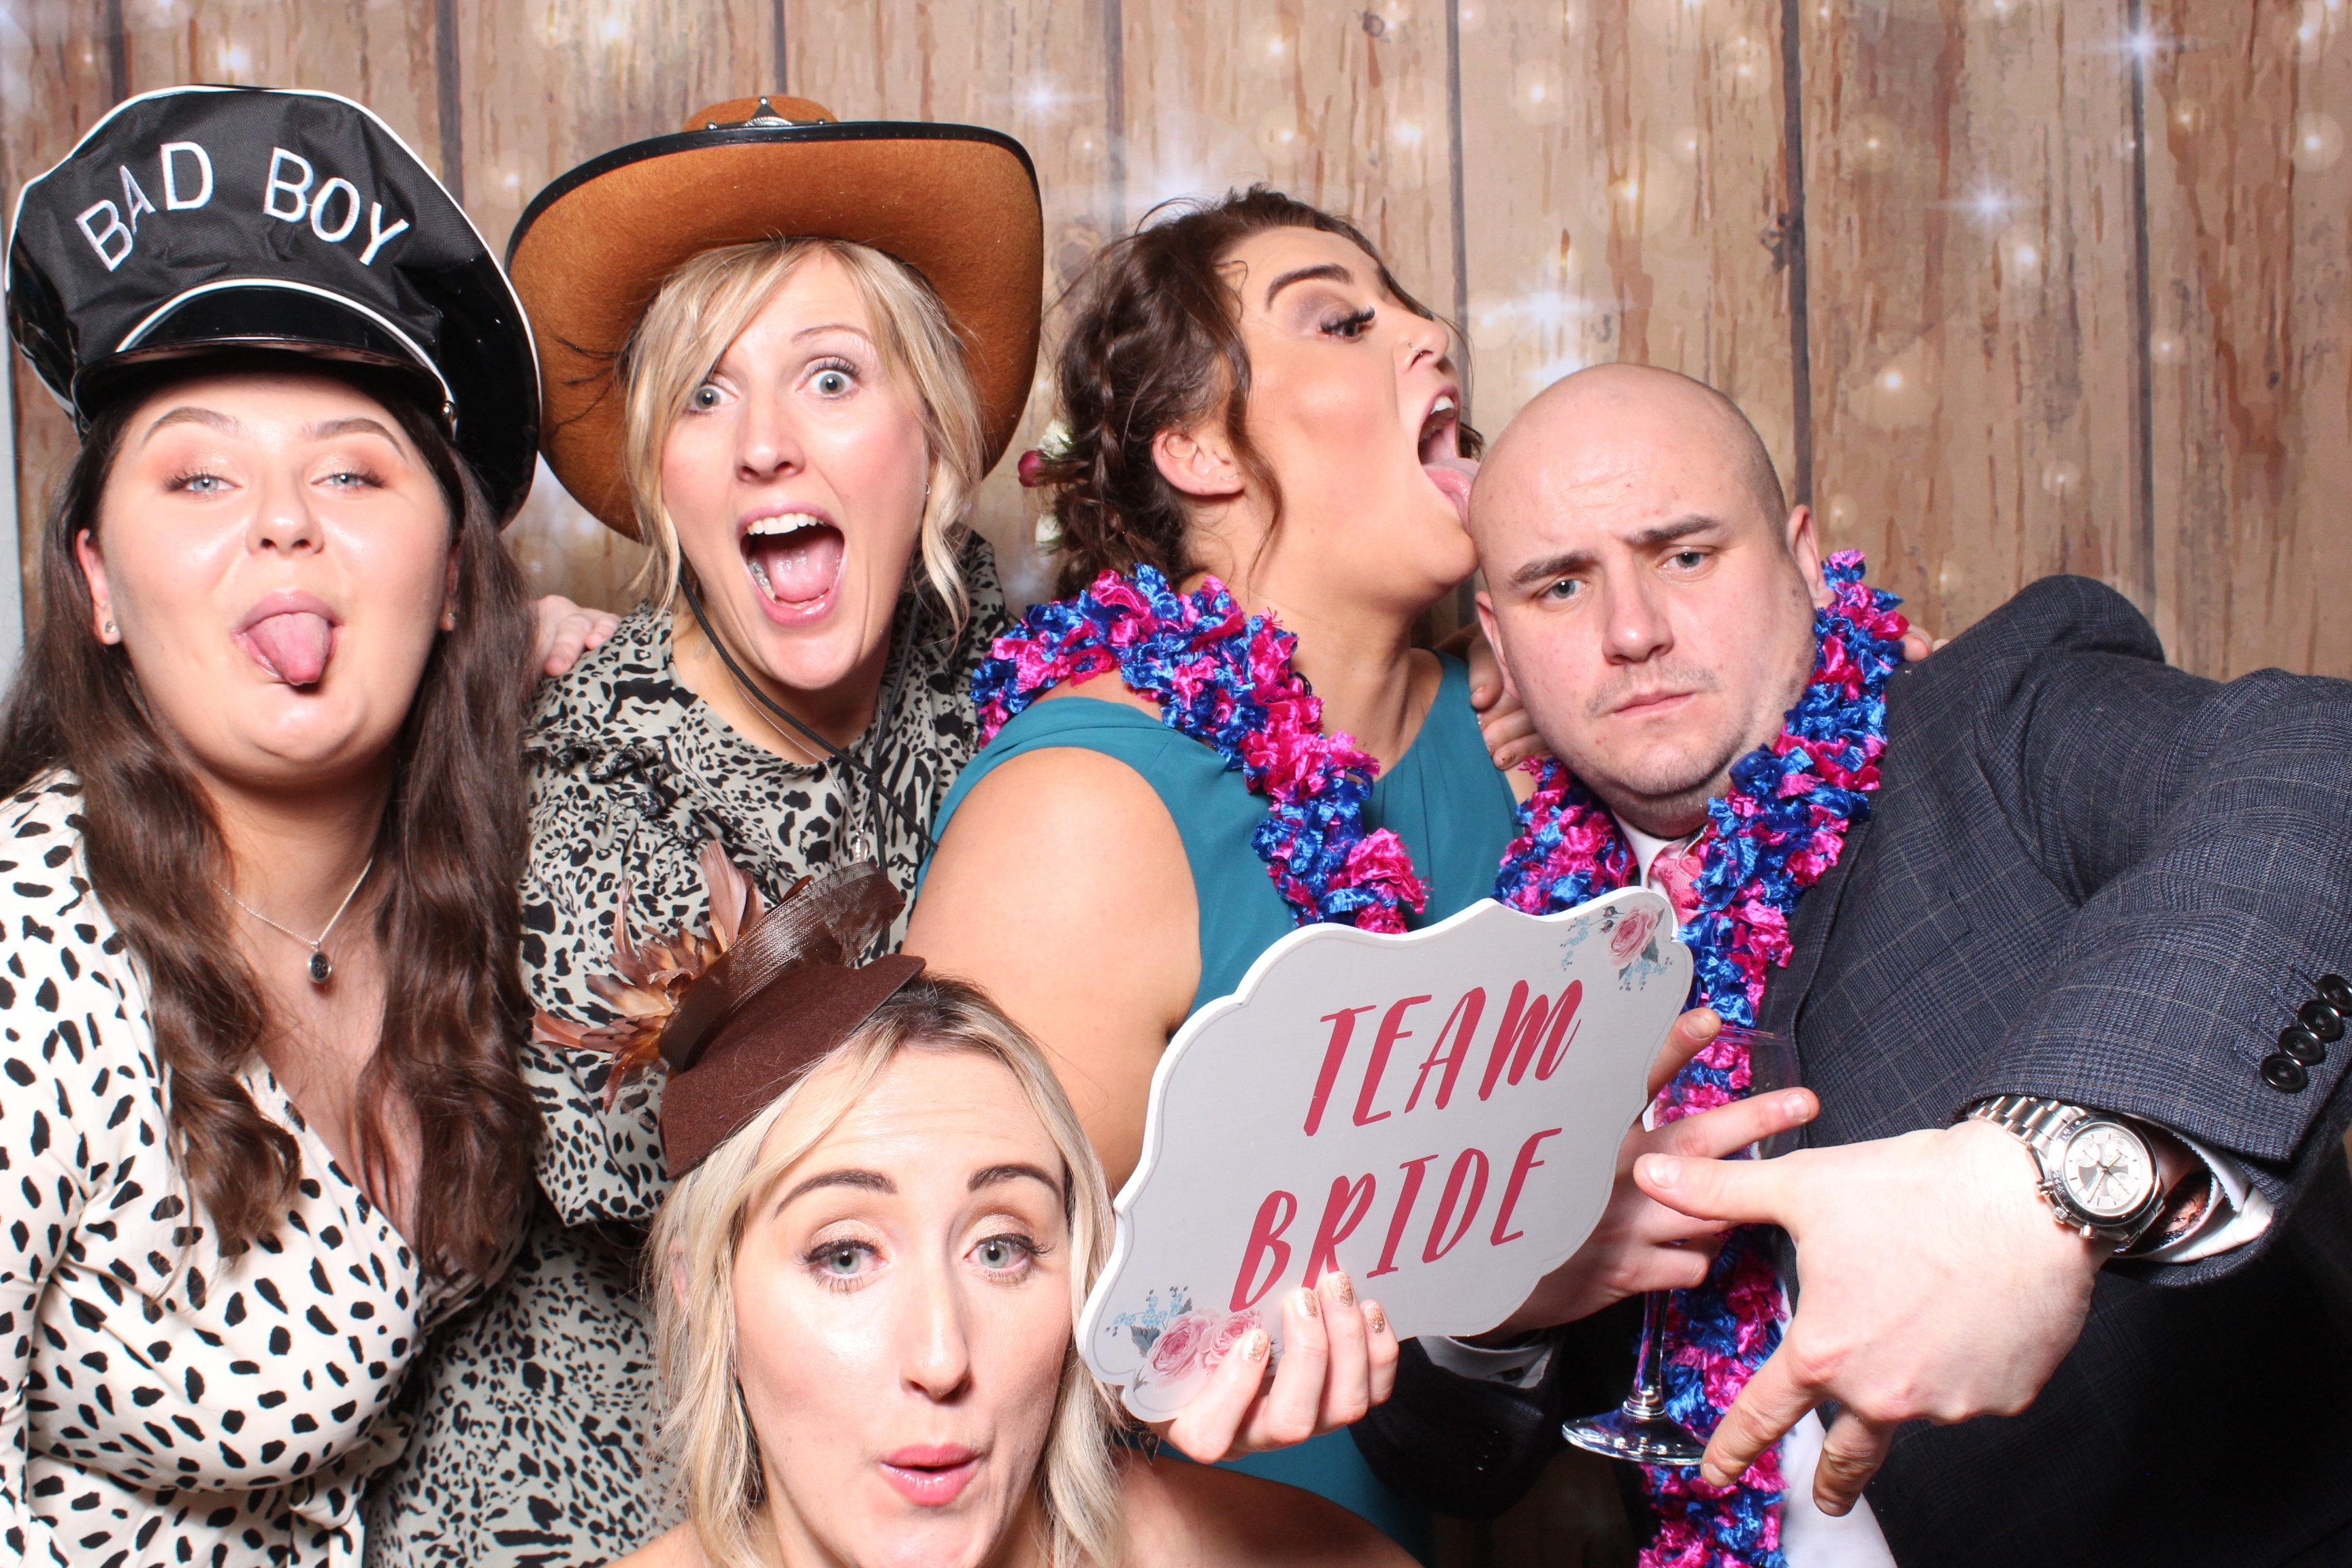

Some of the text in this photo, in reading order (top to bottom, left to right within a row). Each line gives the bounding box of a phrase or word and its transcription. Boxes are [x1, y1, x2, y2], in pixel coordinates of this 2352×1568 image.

[76, 141, 410, 272] BAD BOY
[1303, 979, 1583, 1137] TEAM
[1229, 1127, 1563, 1313] BRIDE
